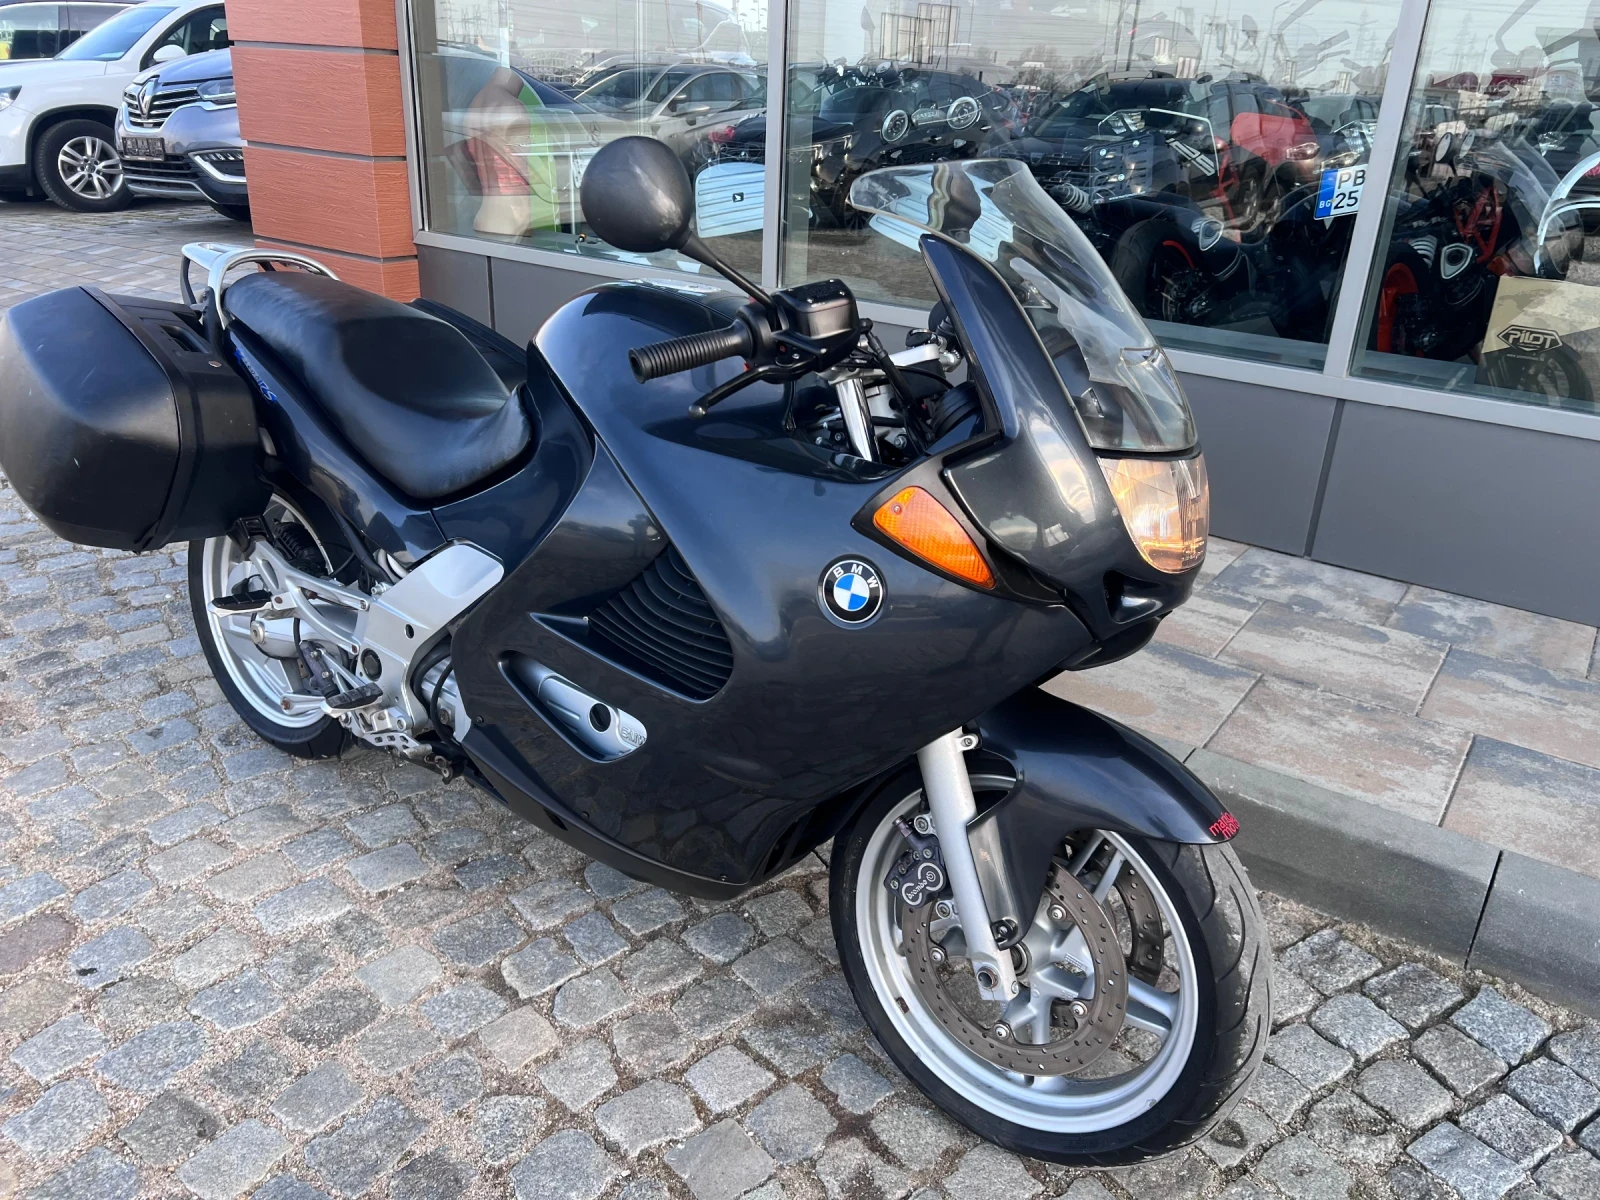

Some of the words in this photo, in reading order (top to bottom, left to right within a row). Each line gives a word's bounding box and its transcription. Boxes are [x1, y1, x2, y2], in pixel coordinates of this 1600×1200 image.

[1337, 169, 1366, 189] PB
[1319, 200, 1331, 208] BG
[1333, 190, 1359, 210] 25
[833, 563, 879, 589] BMW
